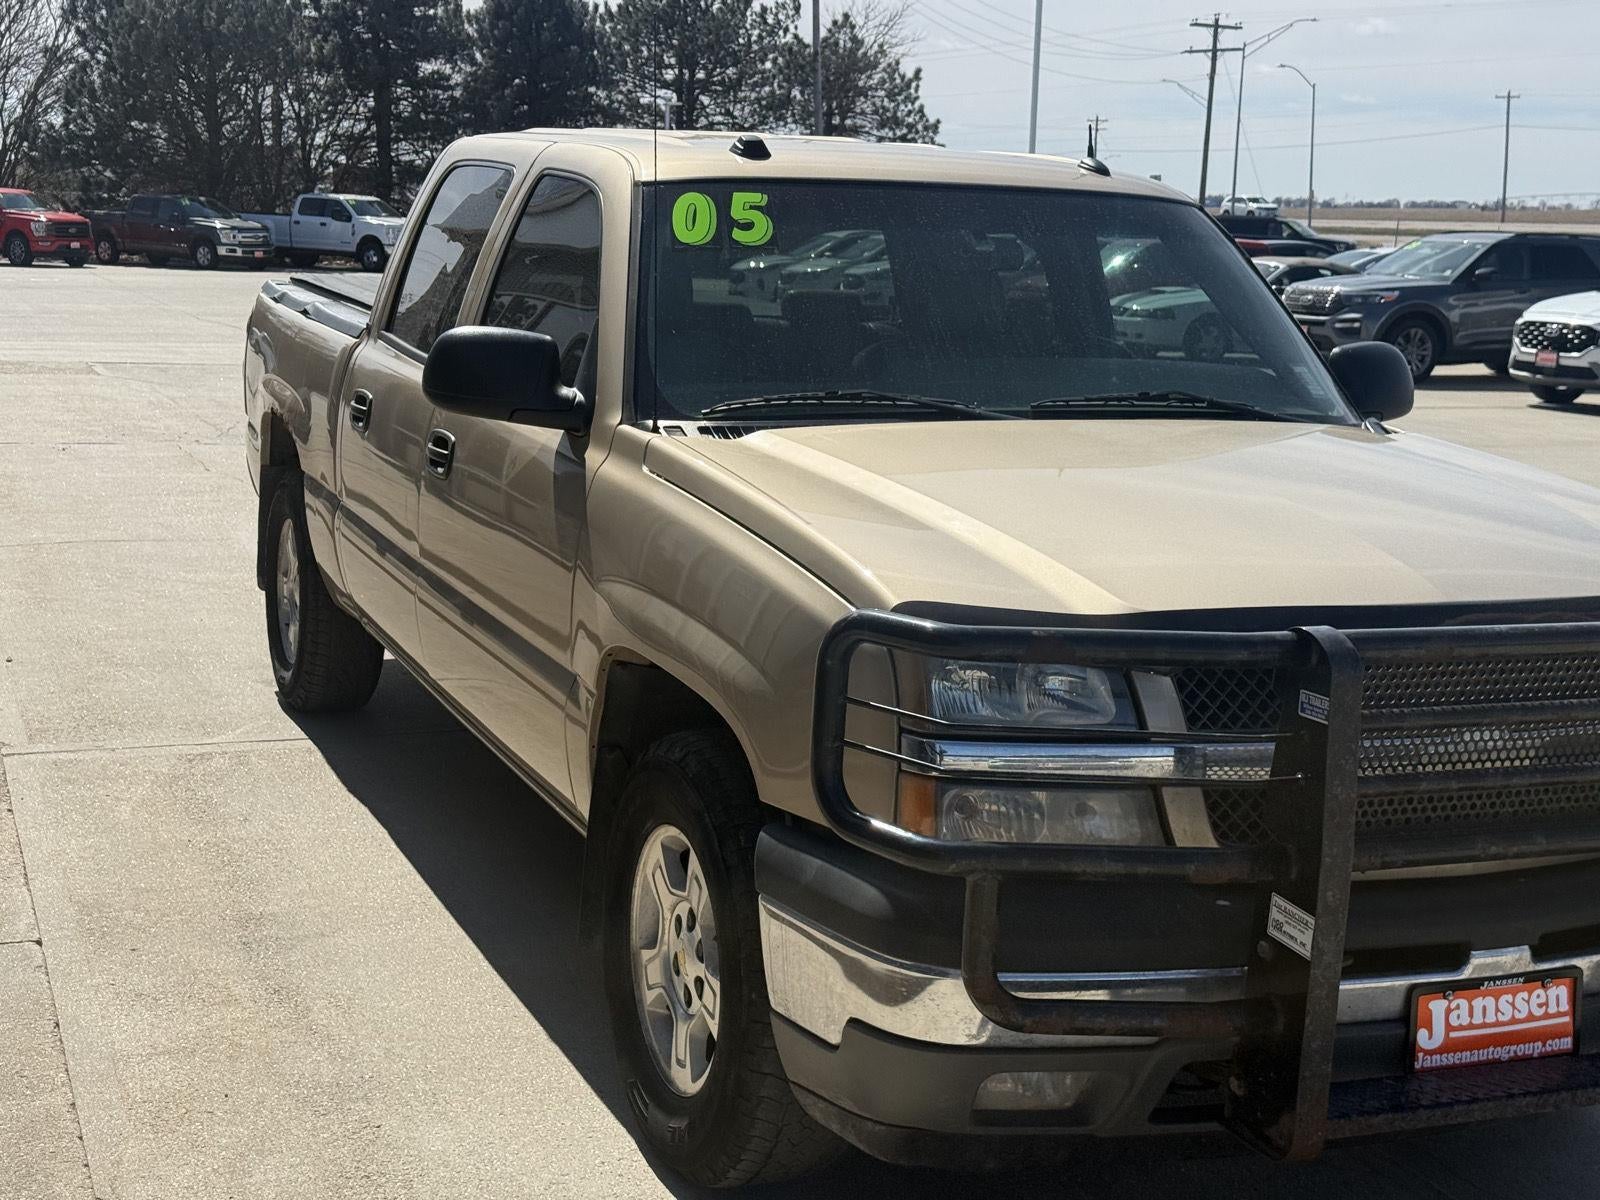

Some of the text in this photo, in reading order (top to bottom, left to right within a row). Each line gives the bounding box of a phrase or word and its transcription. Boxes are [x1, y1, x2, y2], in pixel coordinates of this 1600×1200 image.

[1480, 977, 1525, 990] JANSSEN
[1416, 984, 1569, 1050] Janssen
[1414, 1036, 1573, 1069] Janssenautogroup.com
